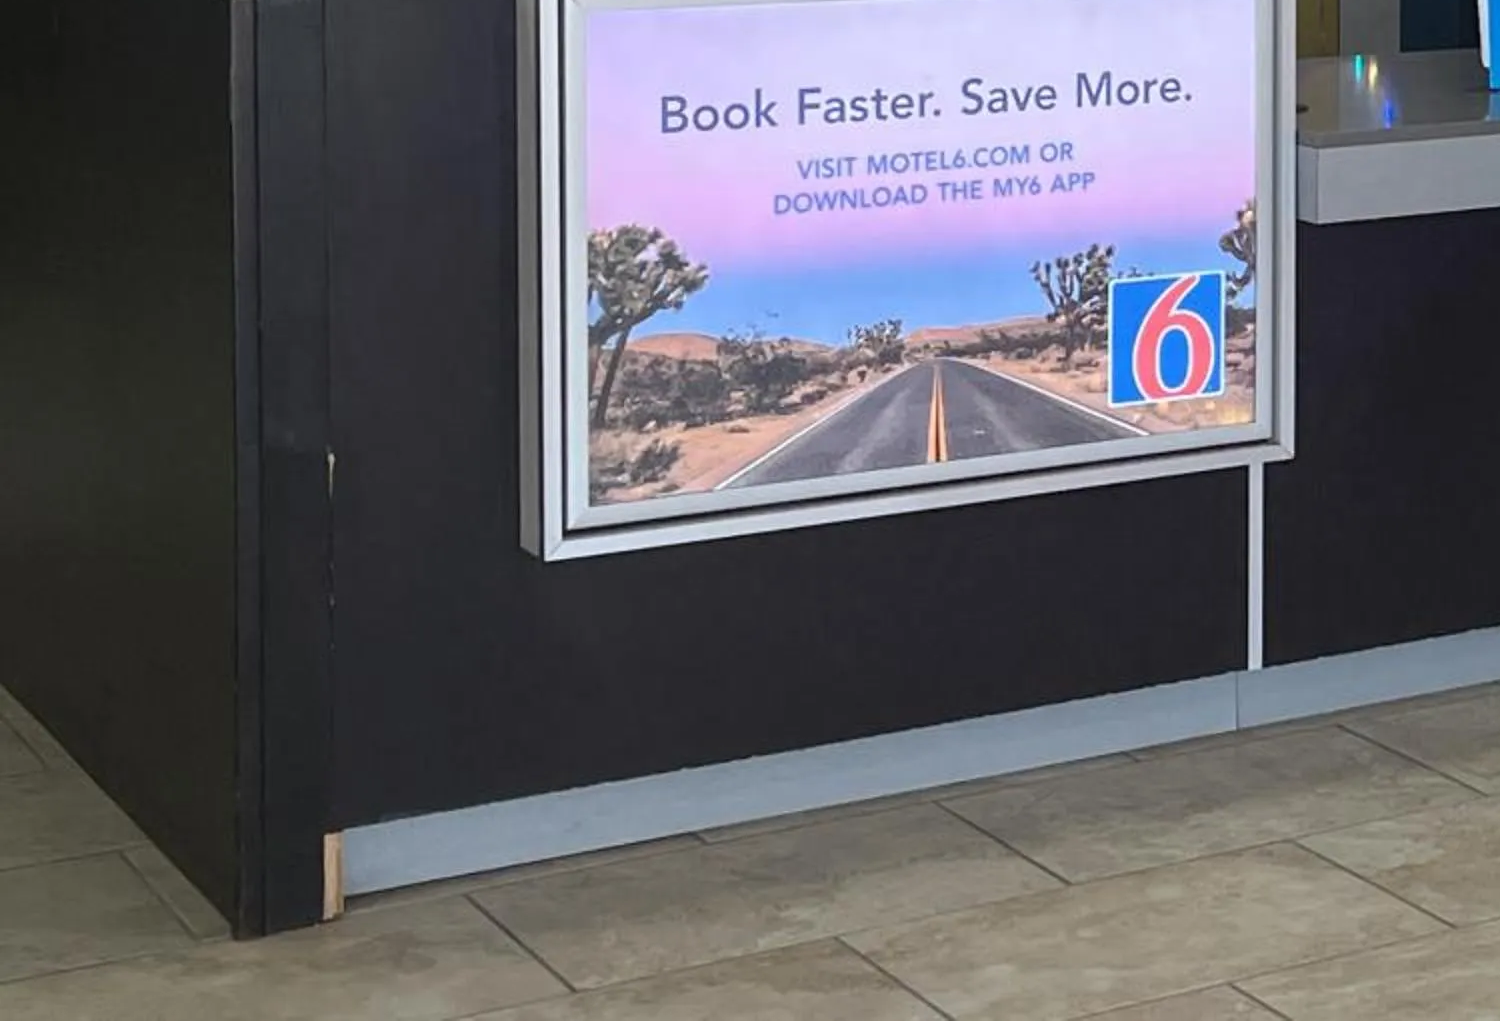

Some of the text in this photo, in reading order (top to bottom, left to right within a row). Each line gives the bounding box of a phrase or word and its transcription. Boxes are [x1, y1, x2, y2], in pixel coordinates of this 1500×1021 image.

[659, 71, 1193, 135] Book Faster. Save More.
[796, 142, 1075, 181] VISIT MOTEL6.COM OR
[773, 171, 1096, 216] DOWNLOAD THE MY6 APP
[1131, 274, 1216, 403] 6
